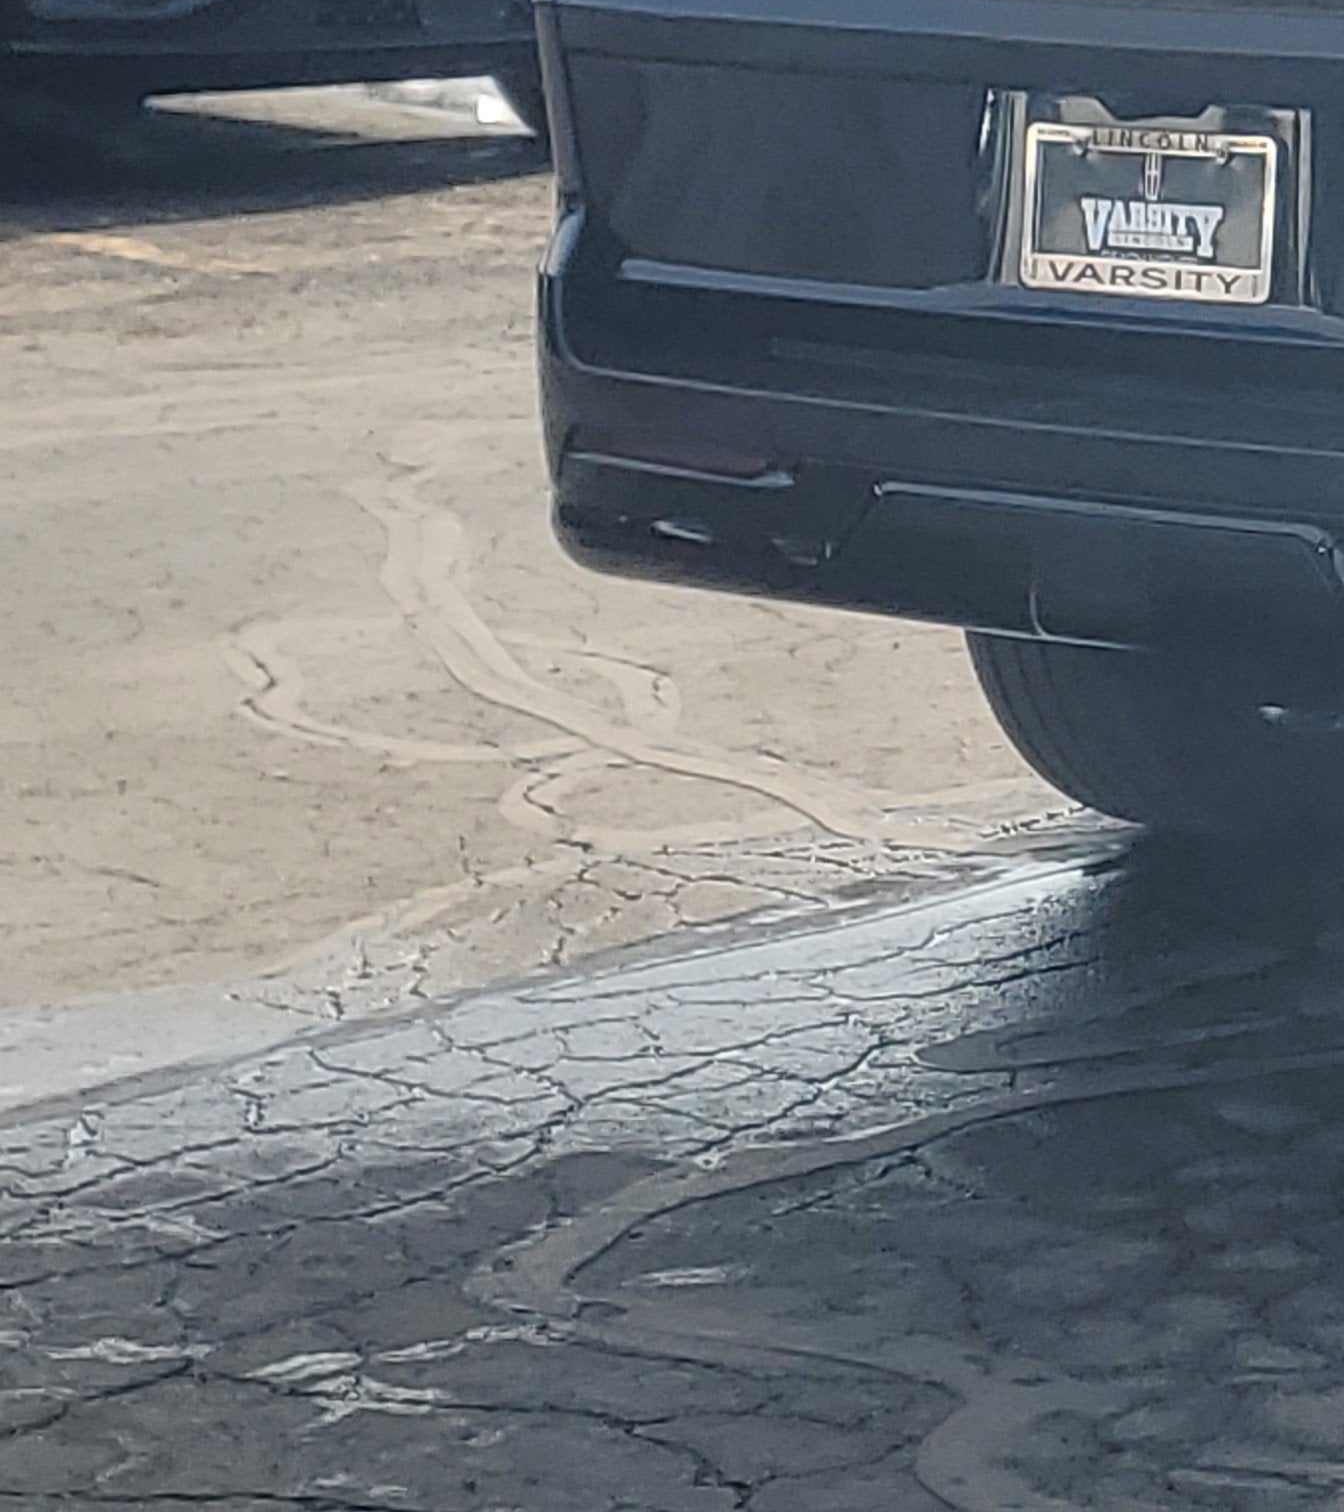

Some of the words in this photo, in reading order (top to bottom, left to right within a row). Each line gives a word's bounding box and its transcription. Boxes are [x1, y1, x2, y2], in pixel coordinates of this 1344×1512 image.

[1091, 128, 1209, 152] LINCOLN
[1081, 197, 1224, 258] VARSITY
[1048, 261, 1242, 294] VARSITY
